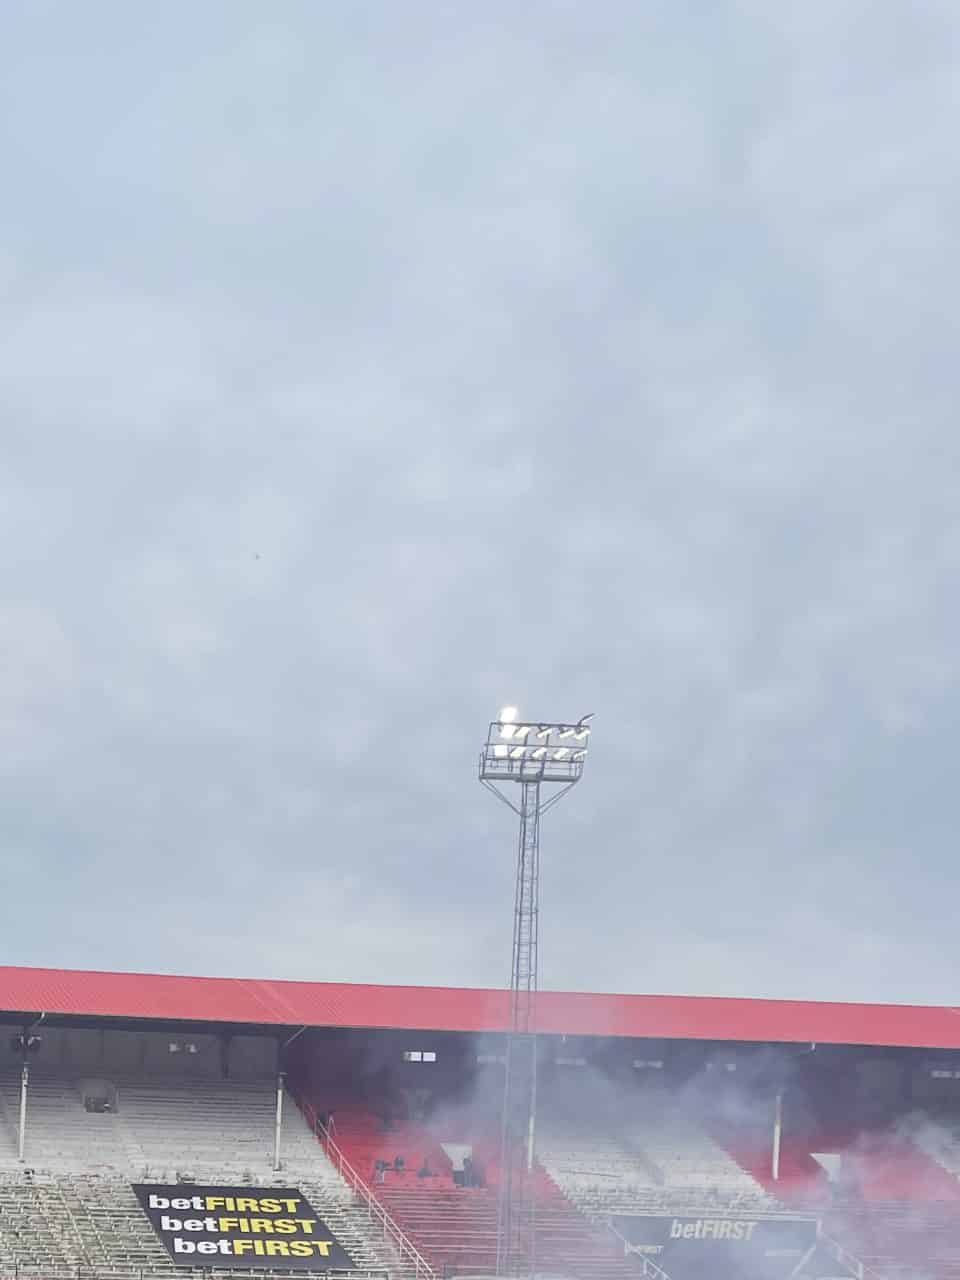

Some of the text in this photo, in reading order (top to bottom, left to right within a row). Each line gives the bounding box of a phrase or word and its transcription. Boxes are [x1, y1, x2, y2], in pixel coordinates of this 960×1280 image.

[149, 1195, 301, 1213] betFIRST
[160, 1215, 318, 1235] betFIRST
[669, 1219, 758, 1241] betFIRST
[174, 1238, 333, 1257] betFIRST
